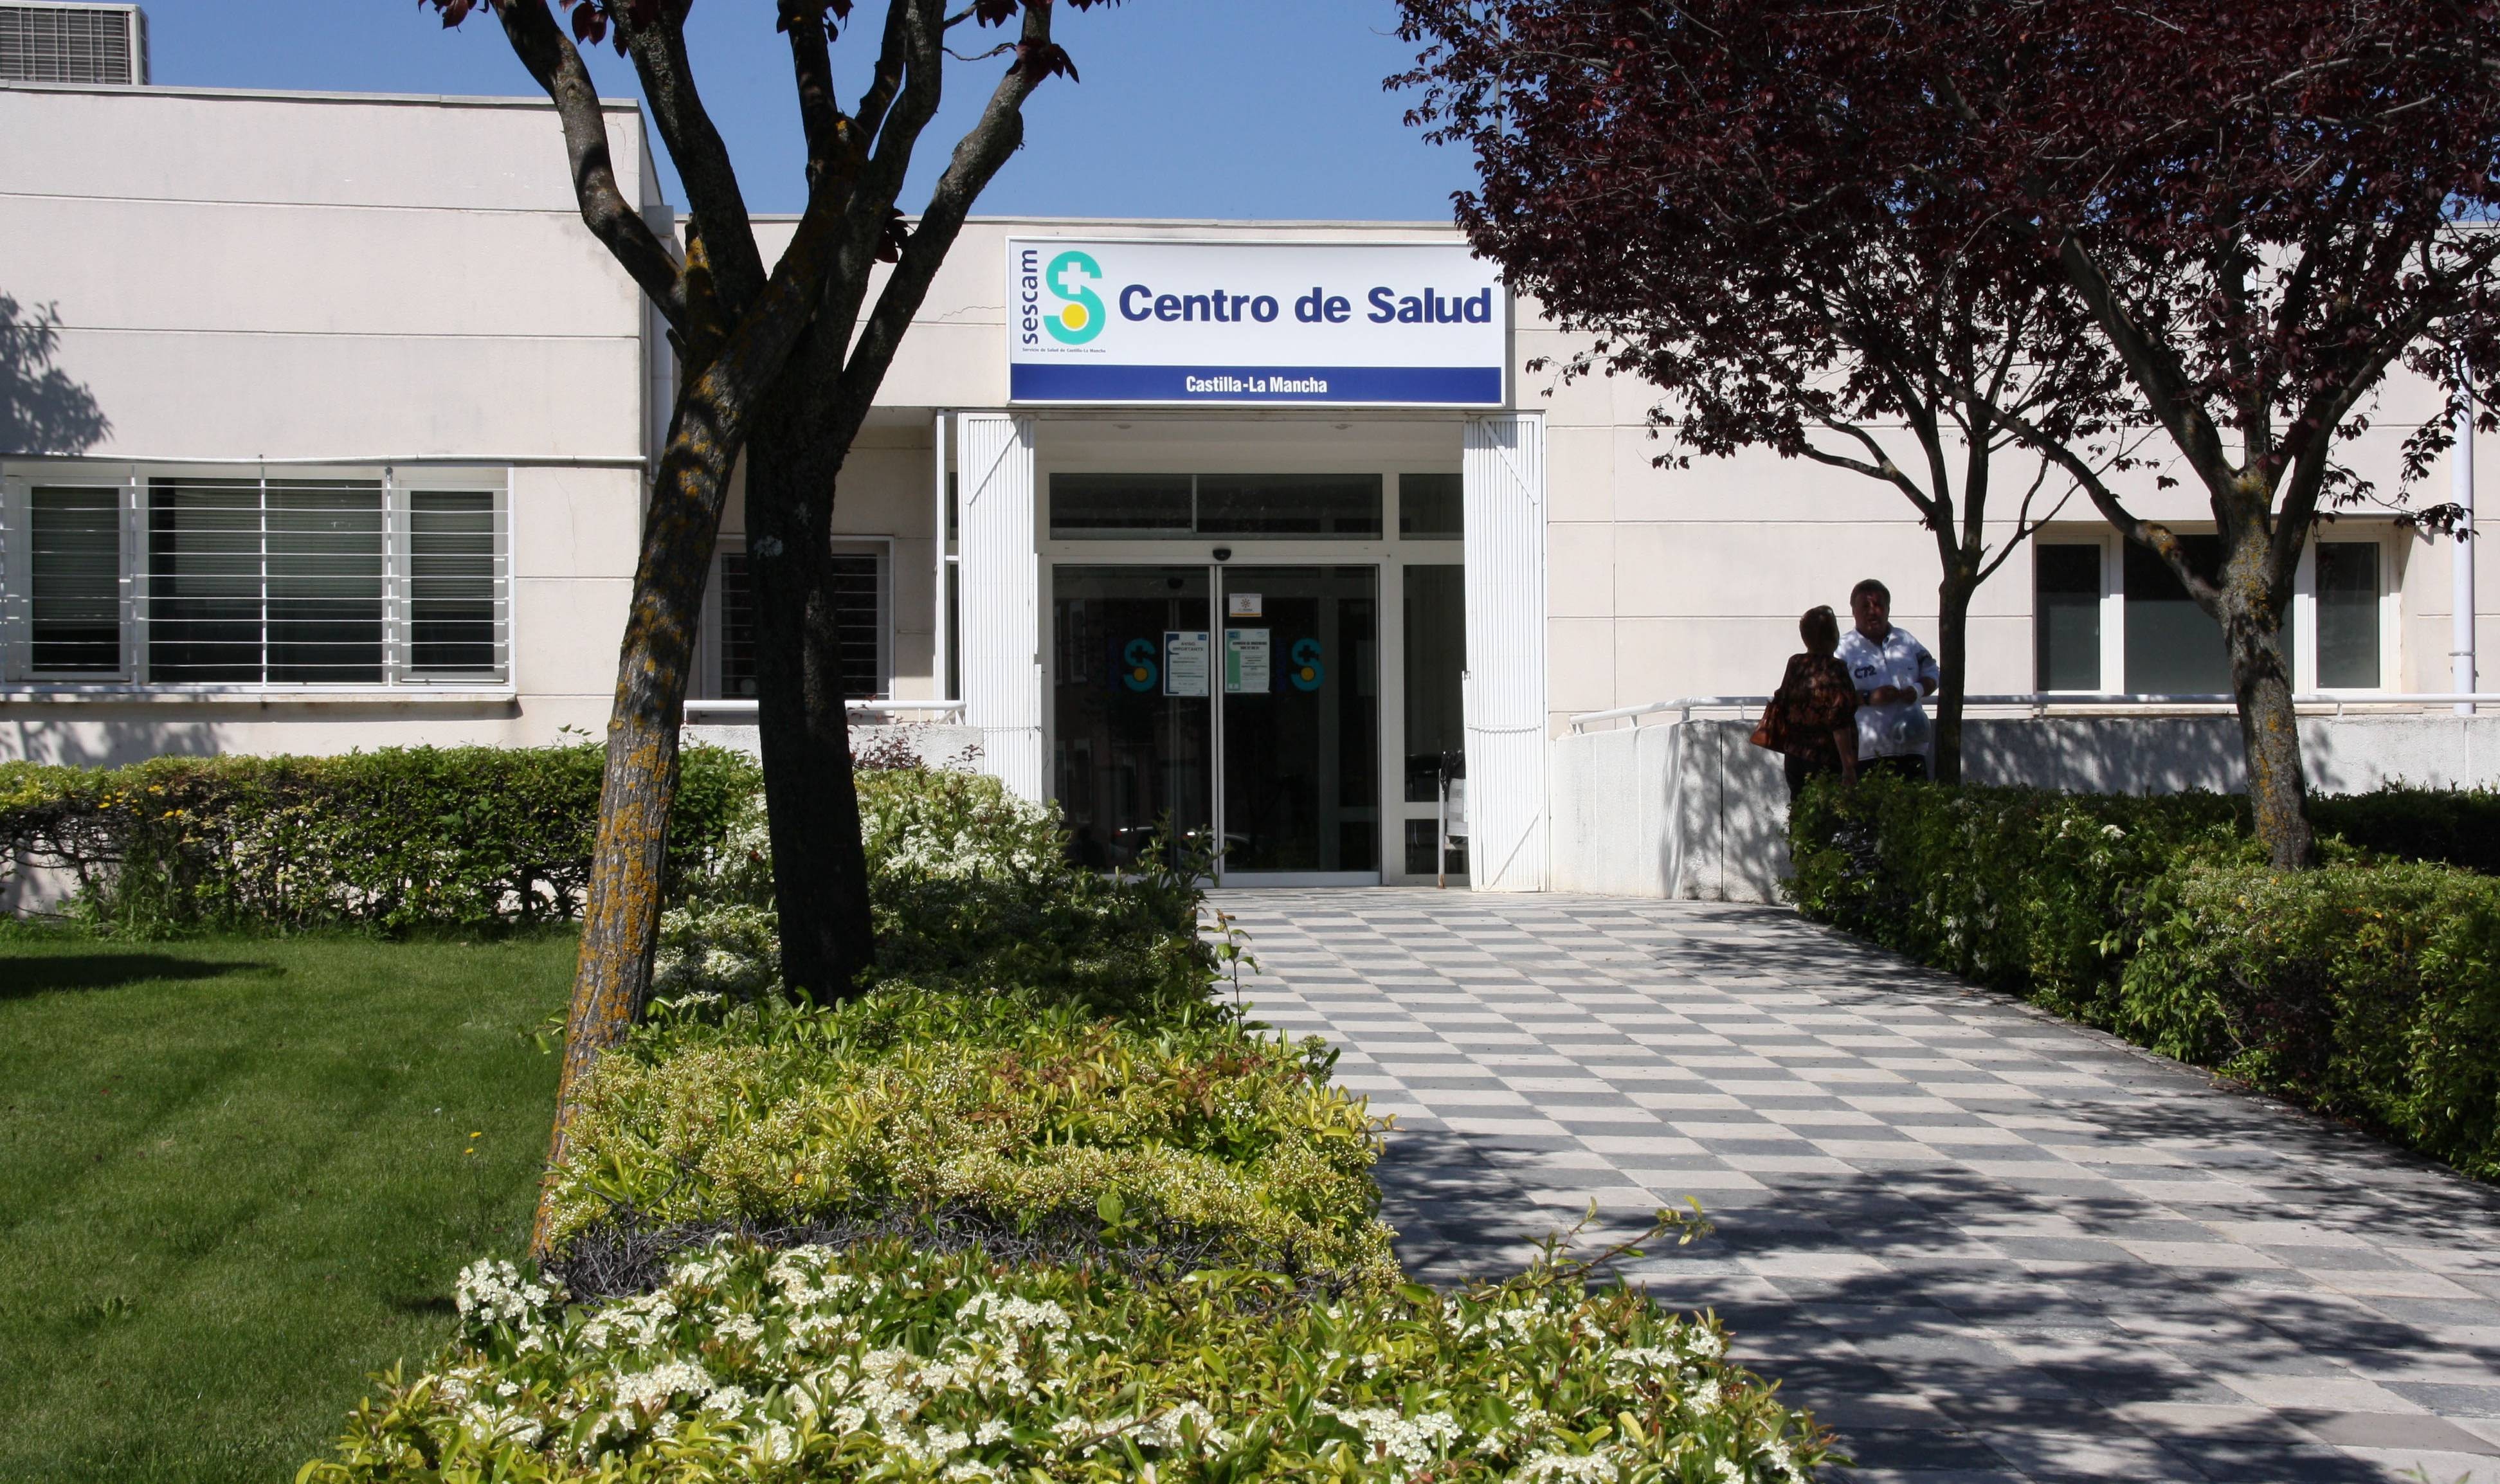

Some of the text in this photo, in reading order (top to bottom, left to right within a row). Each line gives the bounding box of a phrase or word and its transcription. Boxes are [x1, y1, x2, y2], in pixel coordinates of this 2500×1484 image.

[1022, 249, 1038, 345] sescam
[1119, 284, 1492, 323] Centro de Salud
[1186, 376, 1328, 393] Castilla-La Mancha
